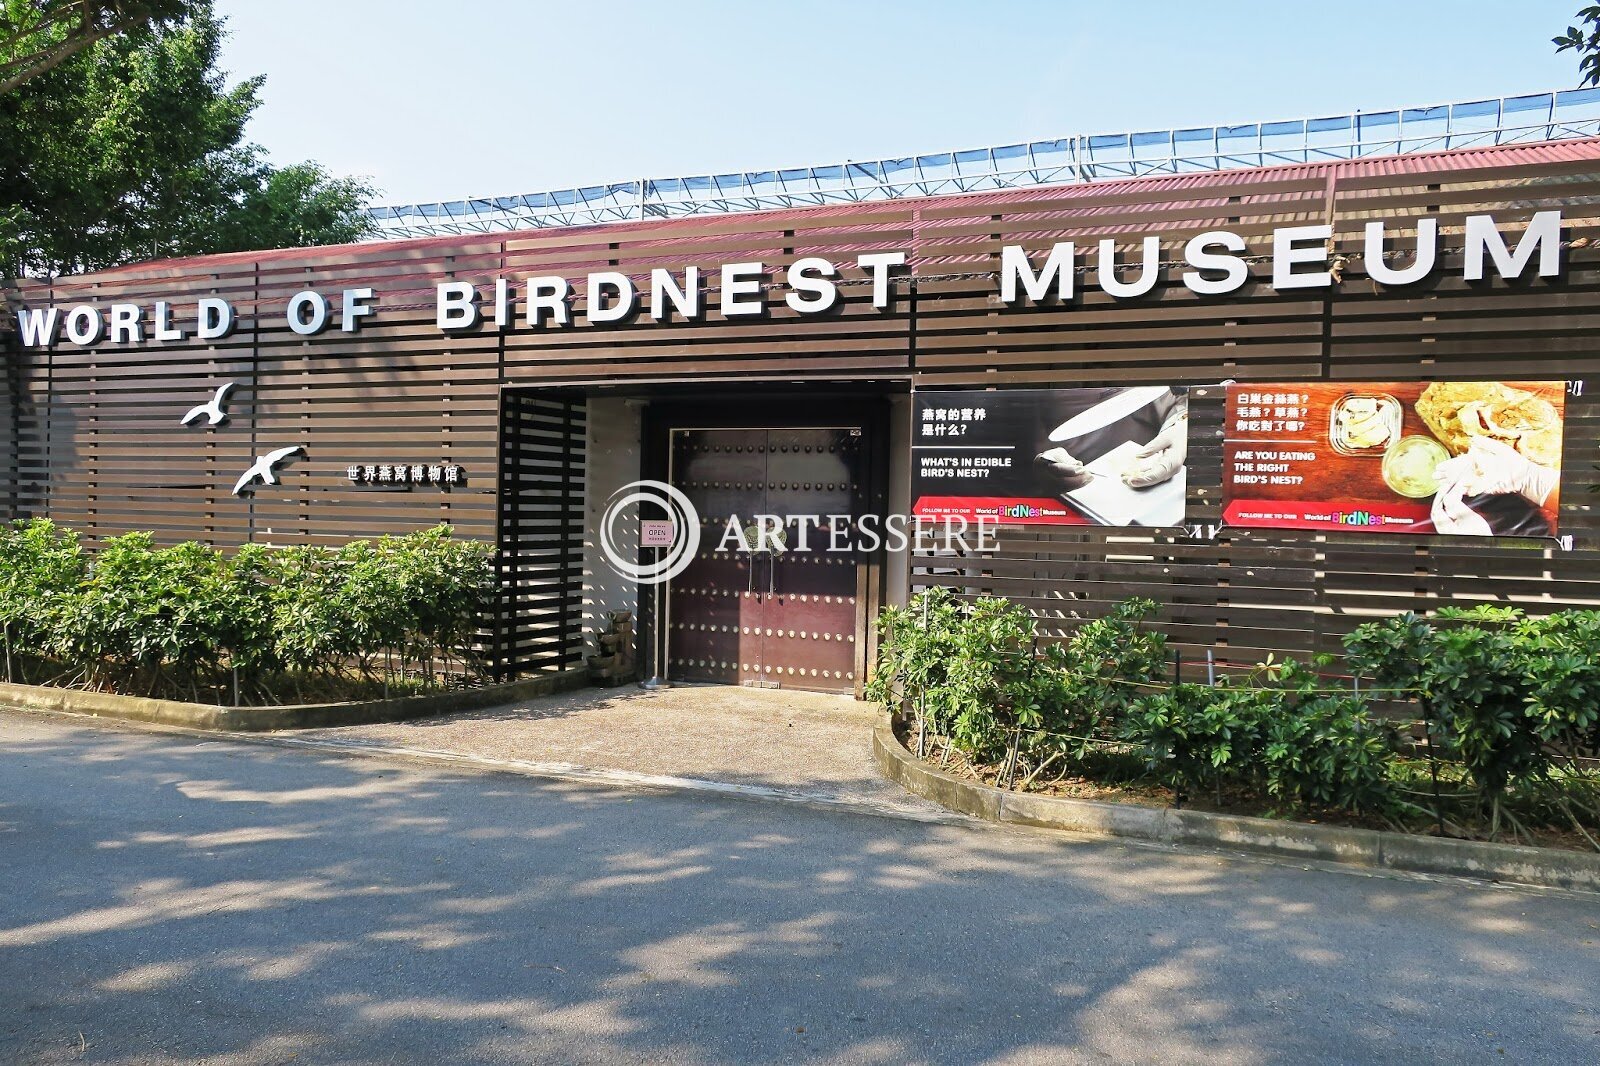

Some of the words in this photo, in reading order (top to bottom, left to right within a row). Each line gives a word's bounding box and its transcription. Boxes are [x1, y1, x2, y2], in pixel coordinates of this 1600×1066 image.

[18, 297, 236, 347] WORLD
[287, 287, 375, 335] OF
[436, 252, 906, 330] BIRDNEST
[1001, 210, 1562, 302] MUSEUM
[922, 408, 987, 421] 燕窝的营养
[1234, 451, 1254, 460] ARE
[1255, 451, 1279, 460] YOU
[1279, 452, 1316, 461] EATING
[921, 458, 959, 467] WHAT'S
[961, 458, 972, 467] IN
[974, 458, 1012, 467] EDIBLE
[920, 468, 955, 478] BIRD'S
[956, 469, 990, 478] NEST?
[1234, 463, 1254, 472] THE
[1256, 463, 1290, 473] RIGHT
[346, 465, 458, 482] 世界燕窝博物馆
[1233, 474, 1268, 484] BIRD'S
[1270, 475, 1304, 485] NEST?
